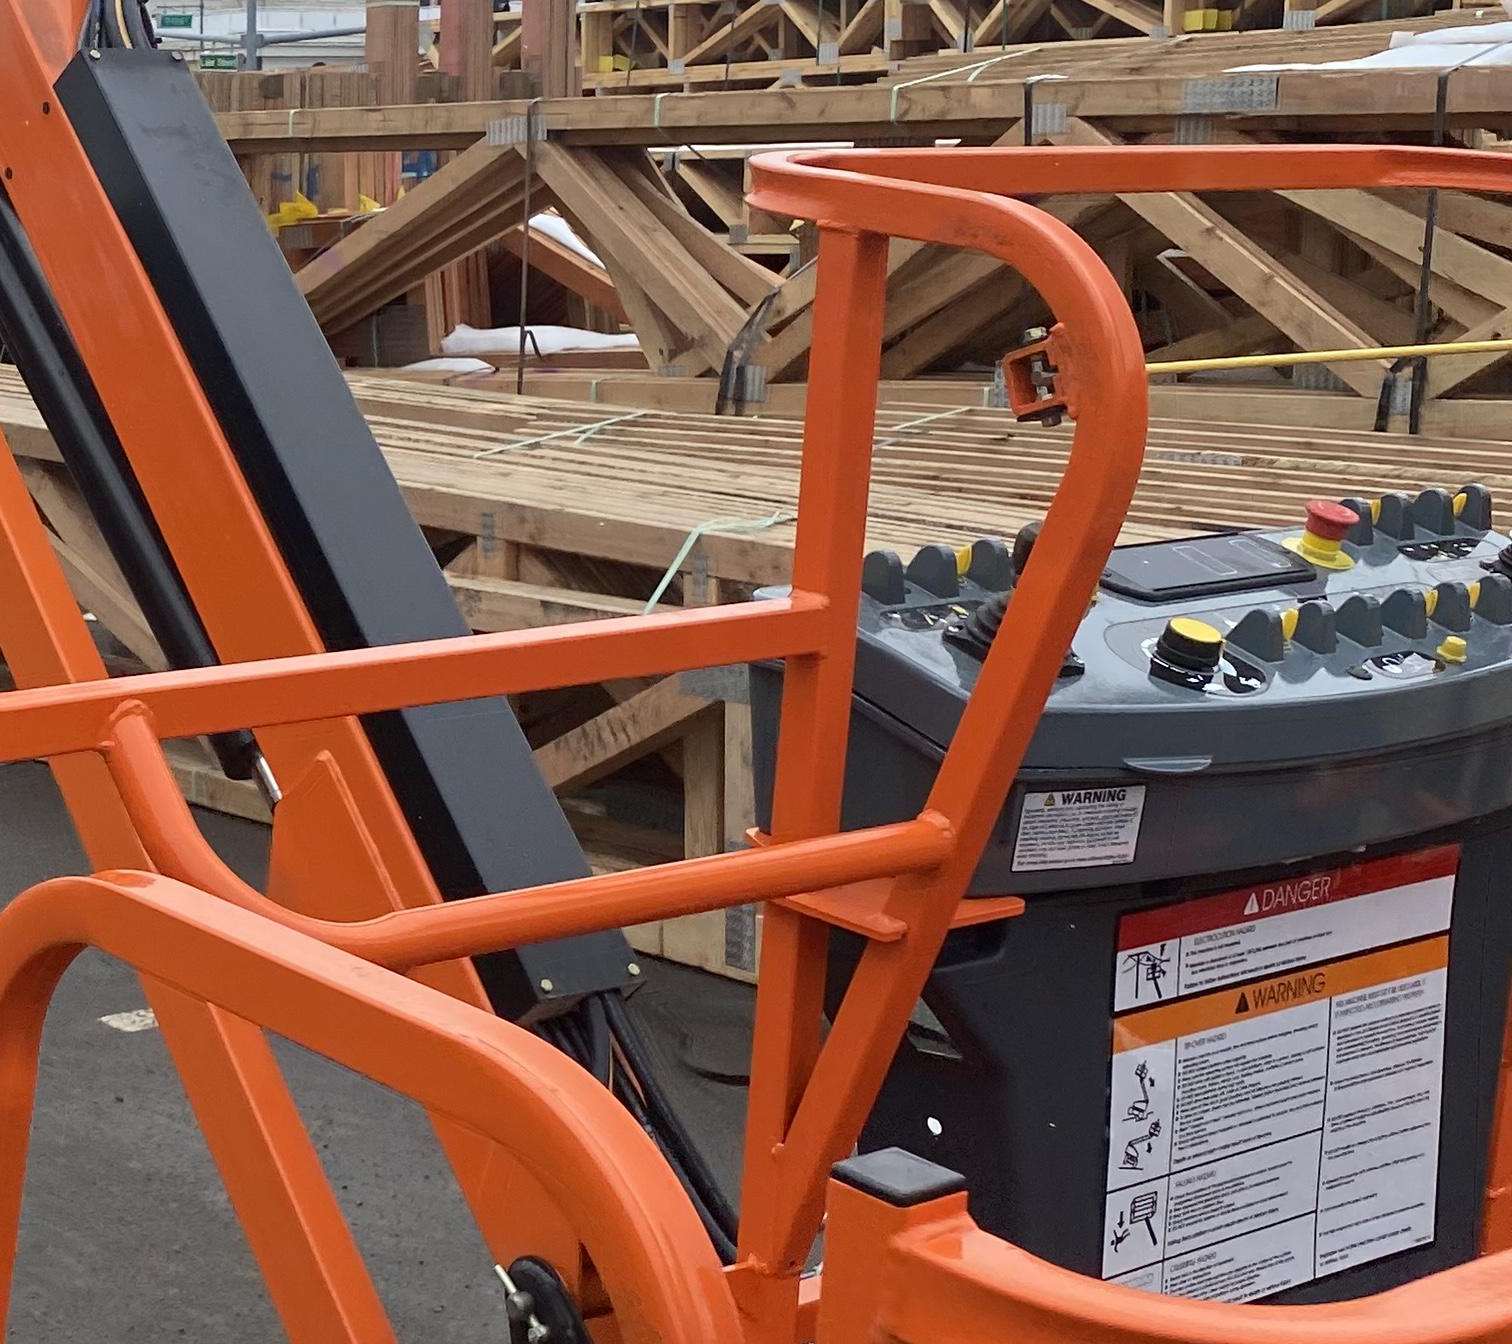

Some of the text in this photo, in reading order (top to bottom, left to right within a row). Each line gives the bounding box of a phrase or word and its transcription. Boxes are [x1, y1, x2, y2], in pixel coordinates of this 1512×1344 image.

[1061, 789, 1127, 806] WARNING
[1262, 876, 1331, 912] DANGER
[1252, 972, 1327, 1009] WARNING
